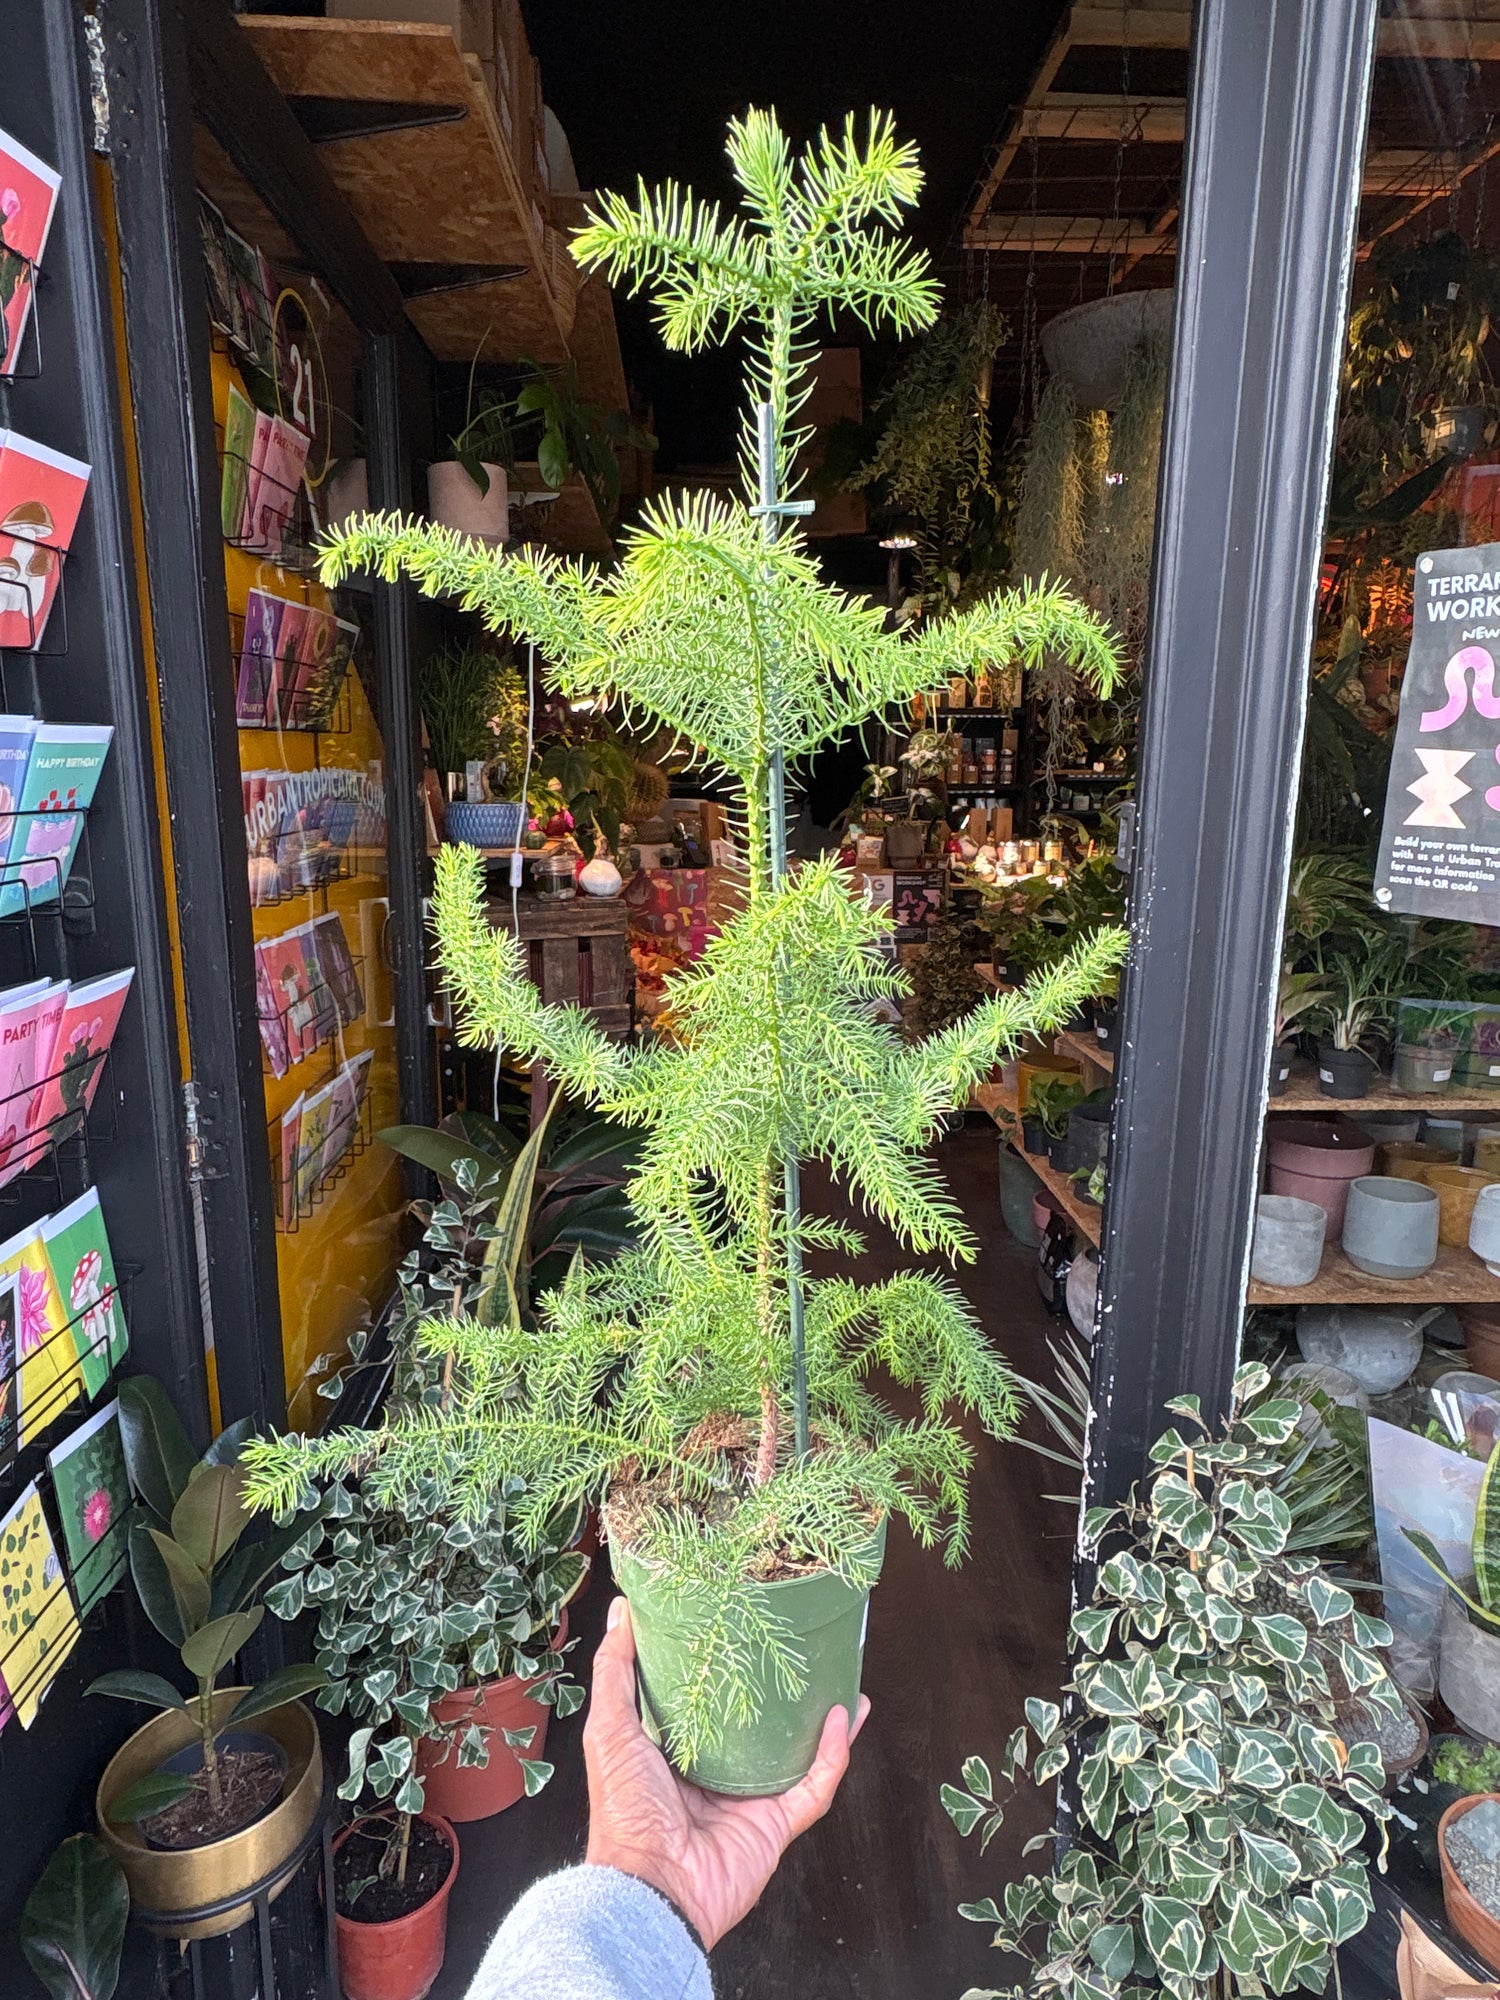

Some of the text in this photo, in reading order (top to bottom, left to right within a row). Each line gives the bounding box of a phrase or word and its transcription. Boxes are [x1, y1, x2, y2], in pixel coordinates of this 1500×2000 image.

[290, 343, 316, 435] 21
[36, 757, 100, 769] HAPPY BIRTHDAY
[1394, 836, 1419, 847] Build
[1420, 840, 1444, 851] your
[1446, 843, 1468, 852] own
[1392, 849, 1414, 860] with
[1417, 853, 1428, 861] us
[1432, 853, 1444, 863] at
[1448, 854, 1482, 866] Urban
[1391, 860, 1495, 881] for more information
[1389, 876, 1479, 892] scan the QR code
[3, 1006, 64, 1046] PARTY TIME
